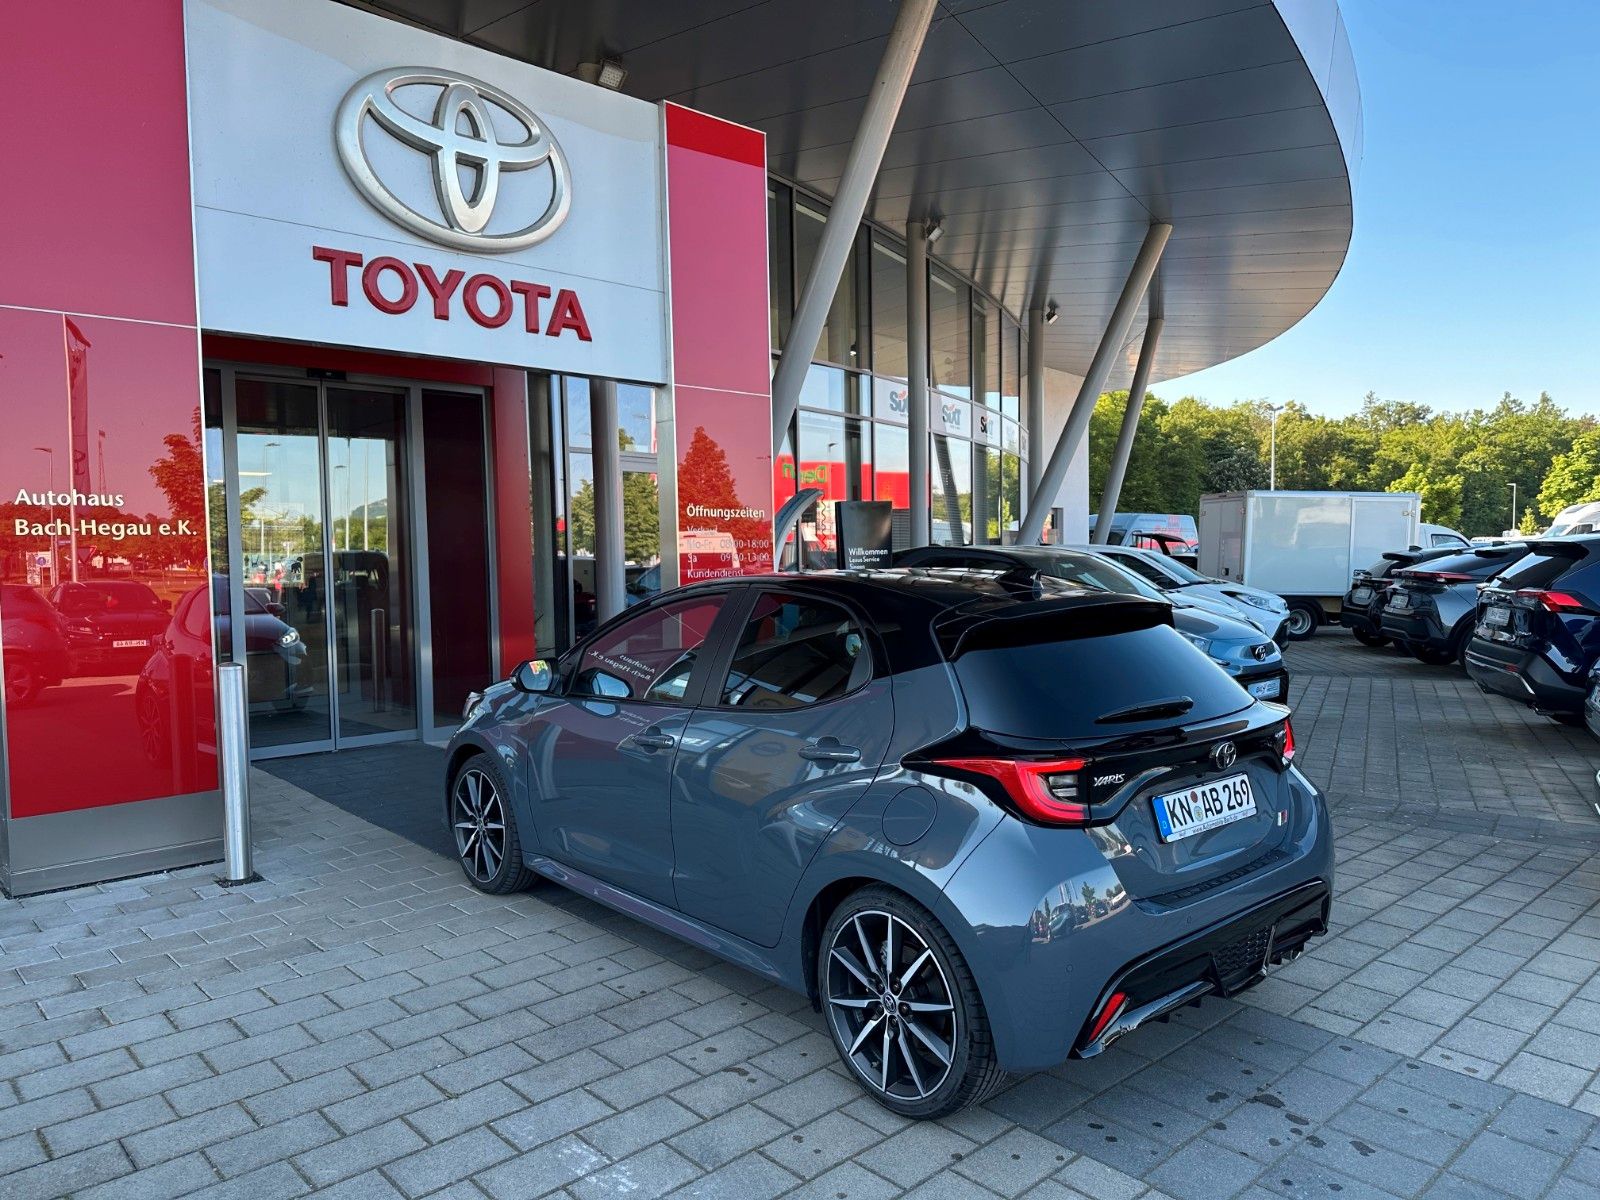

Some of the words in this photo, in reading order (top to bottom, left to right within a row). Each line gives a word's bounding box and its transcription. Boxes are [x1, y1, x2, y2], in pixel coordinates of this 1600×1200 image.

[312, 245, 593, 342] TOYOTA
[14, 488, 125, 507] Autohaus
[686, 503, 765, 520] Öffnungszeiten
[14, 518, 152, 540] Bach-Hegau
[158, 519, 198, 537] e.K.
[687, 553, 698, 563] Sa
[848, 547, 888, 556] Willkommen
[687, 568, 744, 579] Kundendienst
[1093, 773, 1126, 787] YARIS
[1166, 795, 1195, 829] KN
[1201, 787, 1224, 818] AB
[1222, 778, 1250, 812] 269
